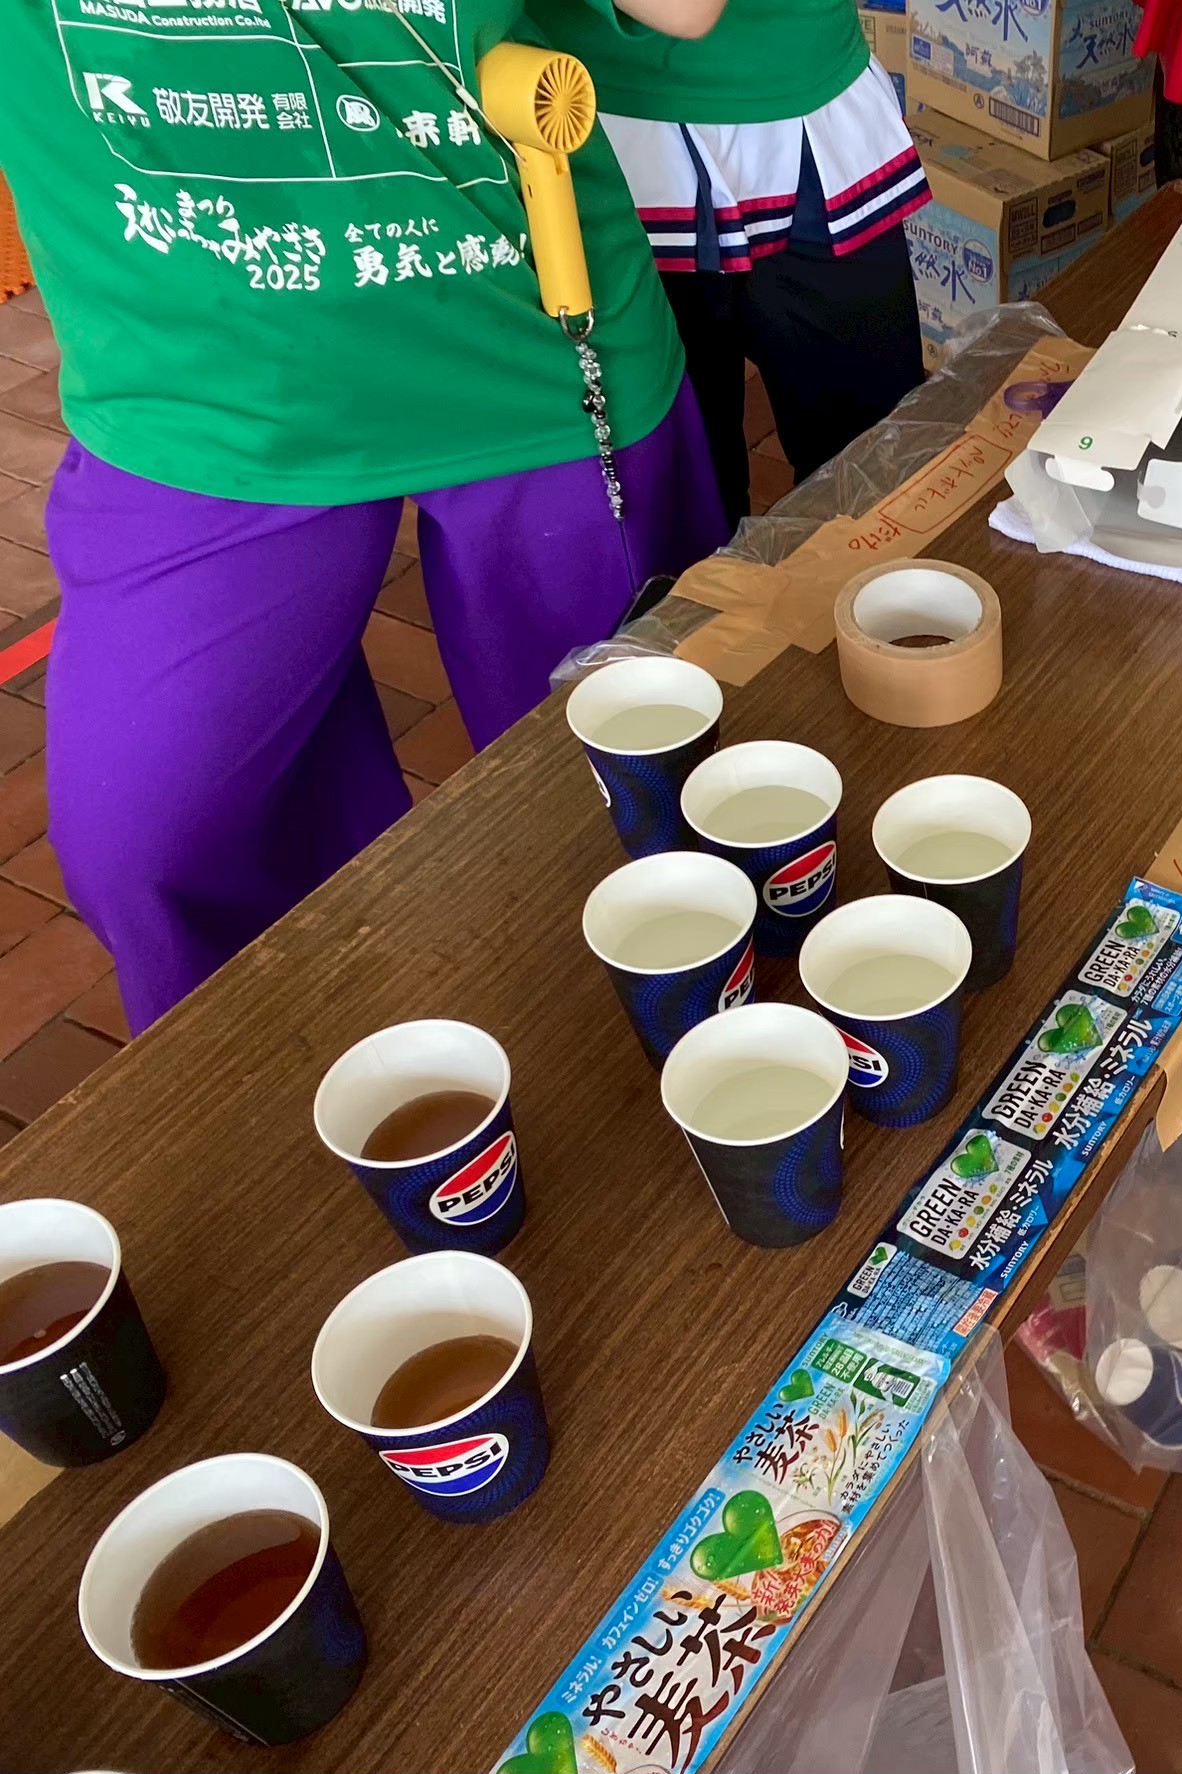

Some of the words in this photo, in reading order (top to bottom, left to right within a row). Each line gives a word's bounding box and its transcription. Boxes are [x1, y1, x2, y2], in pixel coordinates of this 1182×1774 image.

[80, 1, 151, 25] MASUDA
[151, 14, 233, 27] Construction
[93, 111, 151, 128] KEIYU
[152, 87, 270, 130] 敬友開発
[271, 92, 307, 112] 有限
[276, 110, 313, 130] 会社
[344, 217, 440, 243] 全ての人に
[903, 219, 959, 255] SUNTORY
[246, 264, 321, 291] 2025
[904, 239, 976, 304] 然水
[914, 445, 985, 512] ペットボトル
[768, 853, 836, 901] PEPSI
[1084, 940, 1126, 982] GREEN
[991, 1060, 1048, 1120] GREEN
[1114, 1075, 1136, 1106] 低カロリー
[1081, 1121, 1108, 1157] SUNTORY
[438, 1141, 516, 1215] PEPSI
[909, 1177, 963, 1238] GREEN
[1016, 1205, 1040, 1238] 低カロリー
[852, 1265, 875, 1292] GREEN
[999, 1240, 1029, 1279] SUNTORY
[802, 1331, 829, 1369] SUNTORY
[831, 1348, 855, 1377] 28品目
[839, 1353, 865, 1380] 不使用
[807, 1382, 838, 1416] GREEN
[733, 1403, 784, 1465] やさしい
[754, 1408, 820, 1486] 麦茶
[387, 1440, 503, 1478] PEPSI
[839, 1423, 891, 1501] カラダにやさしい
[841, 1419, 910, 1515] 素材を集めてつくった
[601, 1576, 661, 1650] カフェインゼロ!
[581, 1590, 694, 1726] やさしい
[560, 1654, 603, 1705] ミネラル!
[627, 1592, 777, 1774] 麦茶
